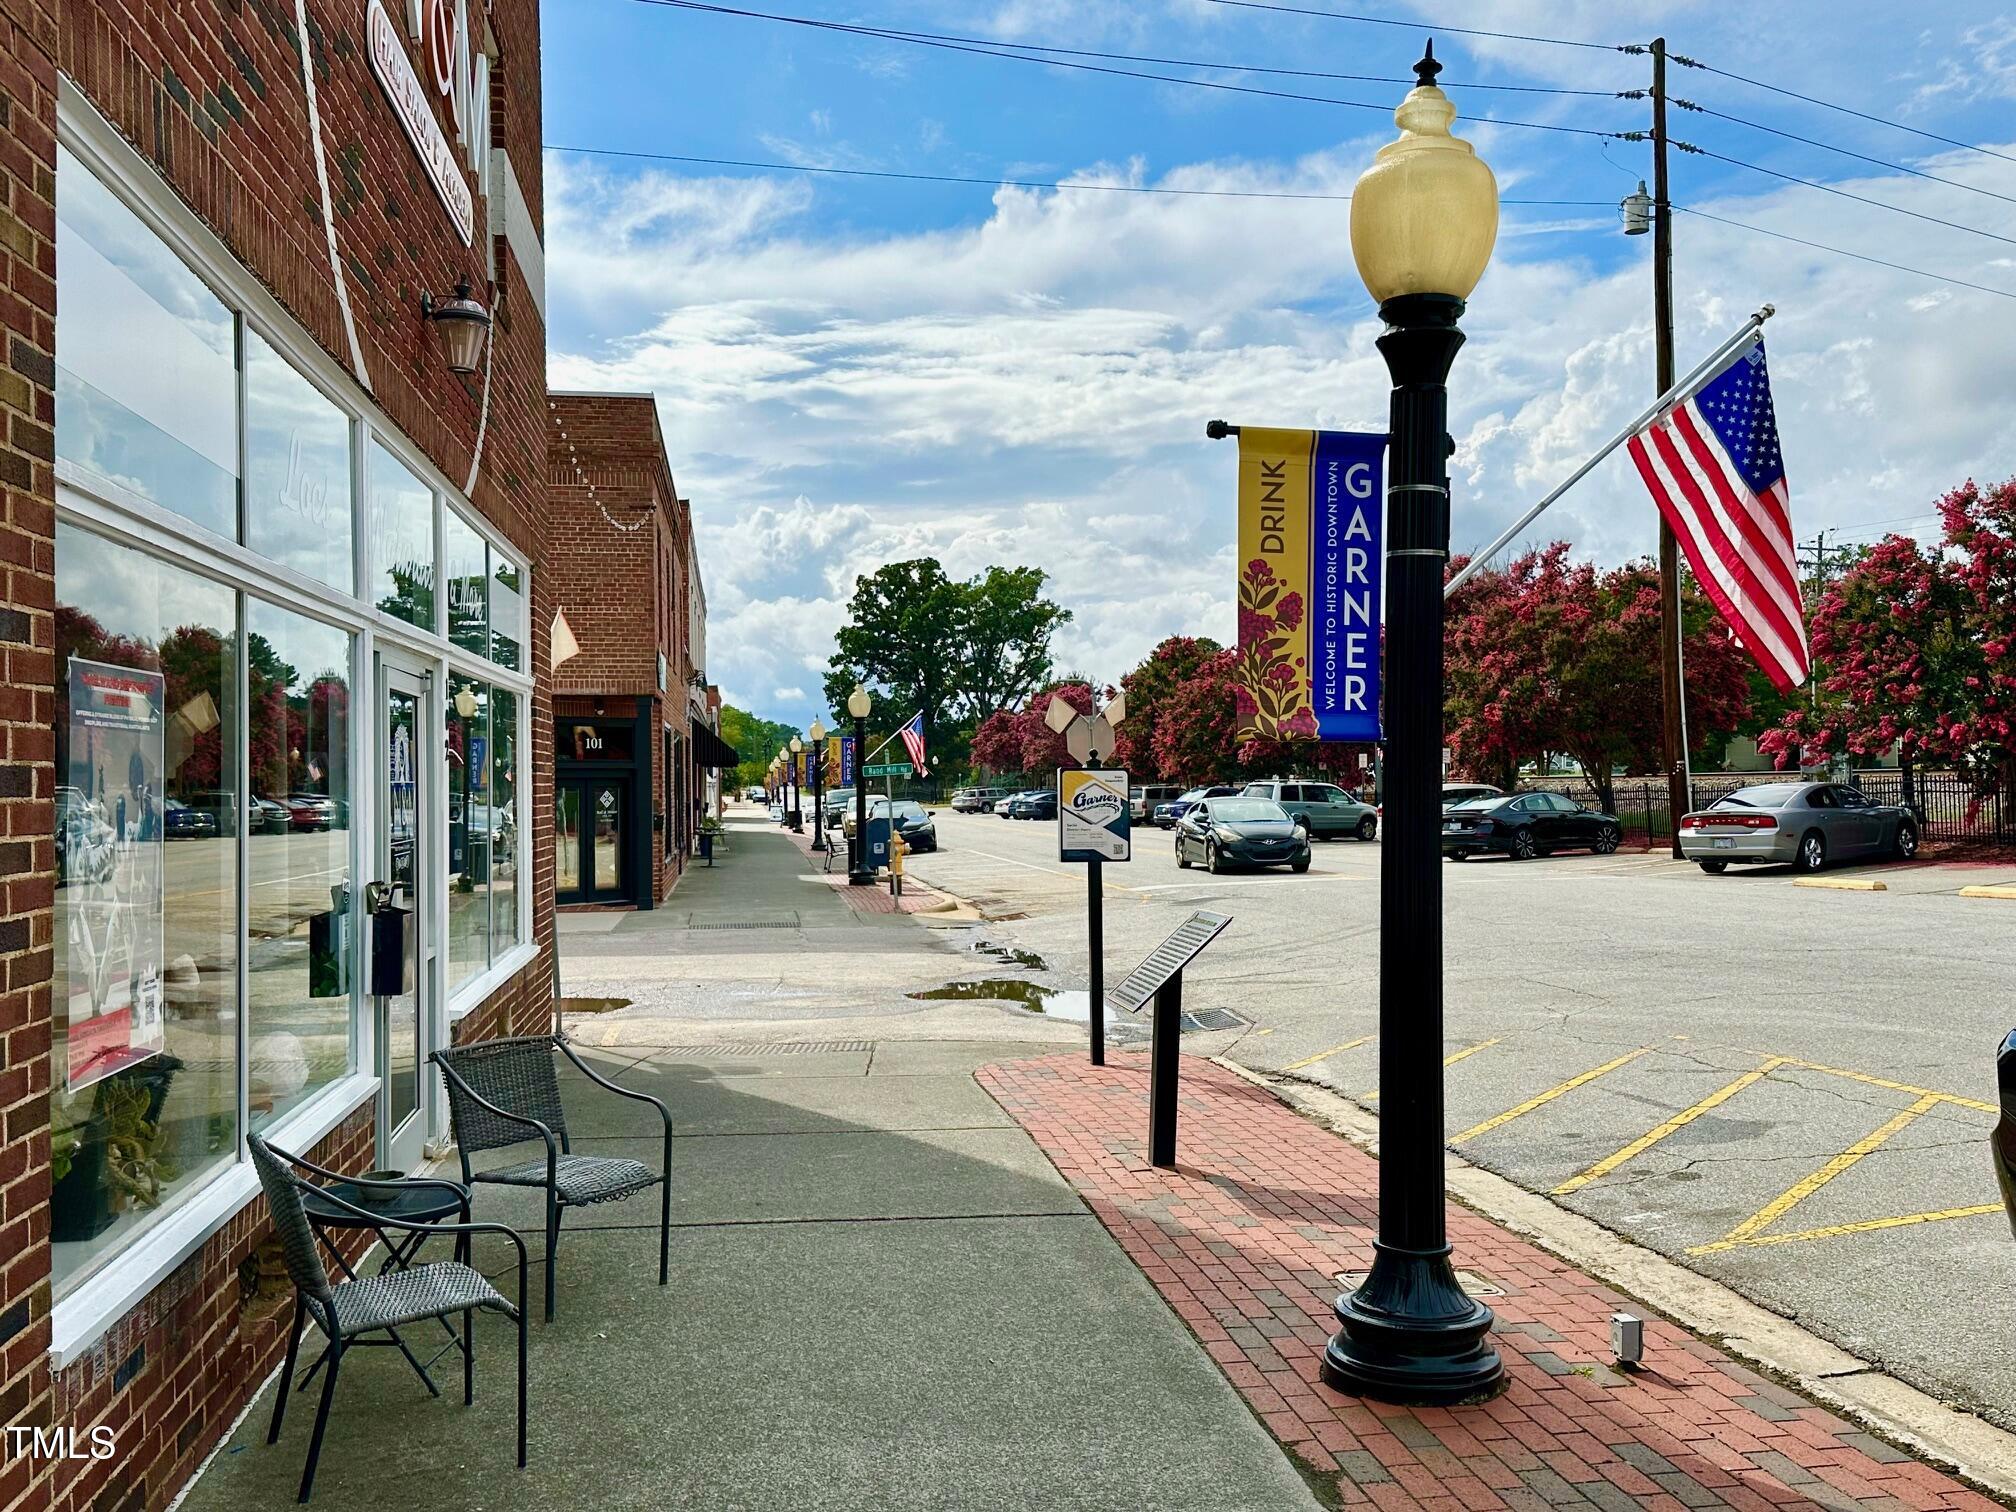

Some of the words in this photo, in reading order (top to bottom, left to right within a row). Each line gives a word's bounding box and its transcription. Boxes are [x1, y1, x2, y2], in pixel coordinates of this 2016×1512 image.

[377, 19, 403, 90] HAIR
[405, 78, 431, 151] SALON
[1260, 460, 1287, 554] DRINK
[1327, 461, 1338, 547] DOWNTOWN
[1326, 552, 1337, 612] HISTORIC
[1344, 463, 1372, 711] GARNER
[1326, 618, 1336, 637] TO
[1325, 640, 1336, 709] WELCOME
[585, 737, 603, 749] 101
[868, 767, 883, 775] Rand
[886, 766, 897, 774] Mill
[1073, 792, 1119, 808] Garner
